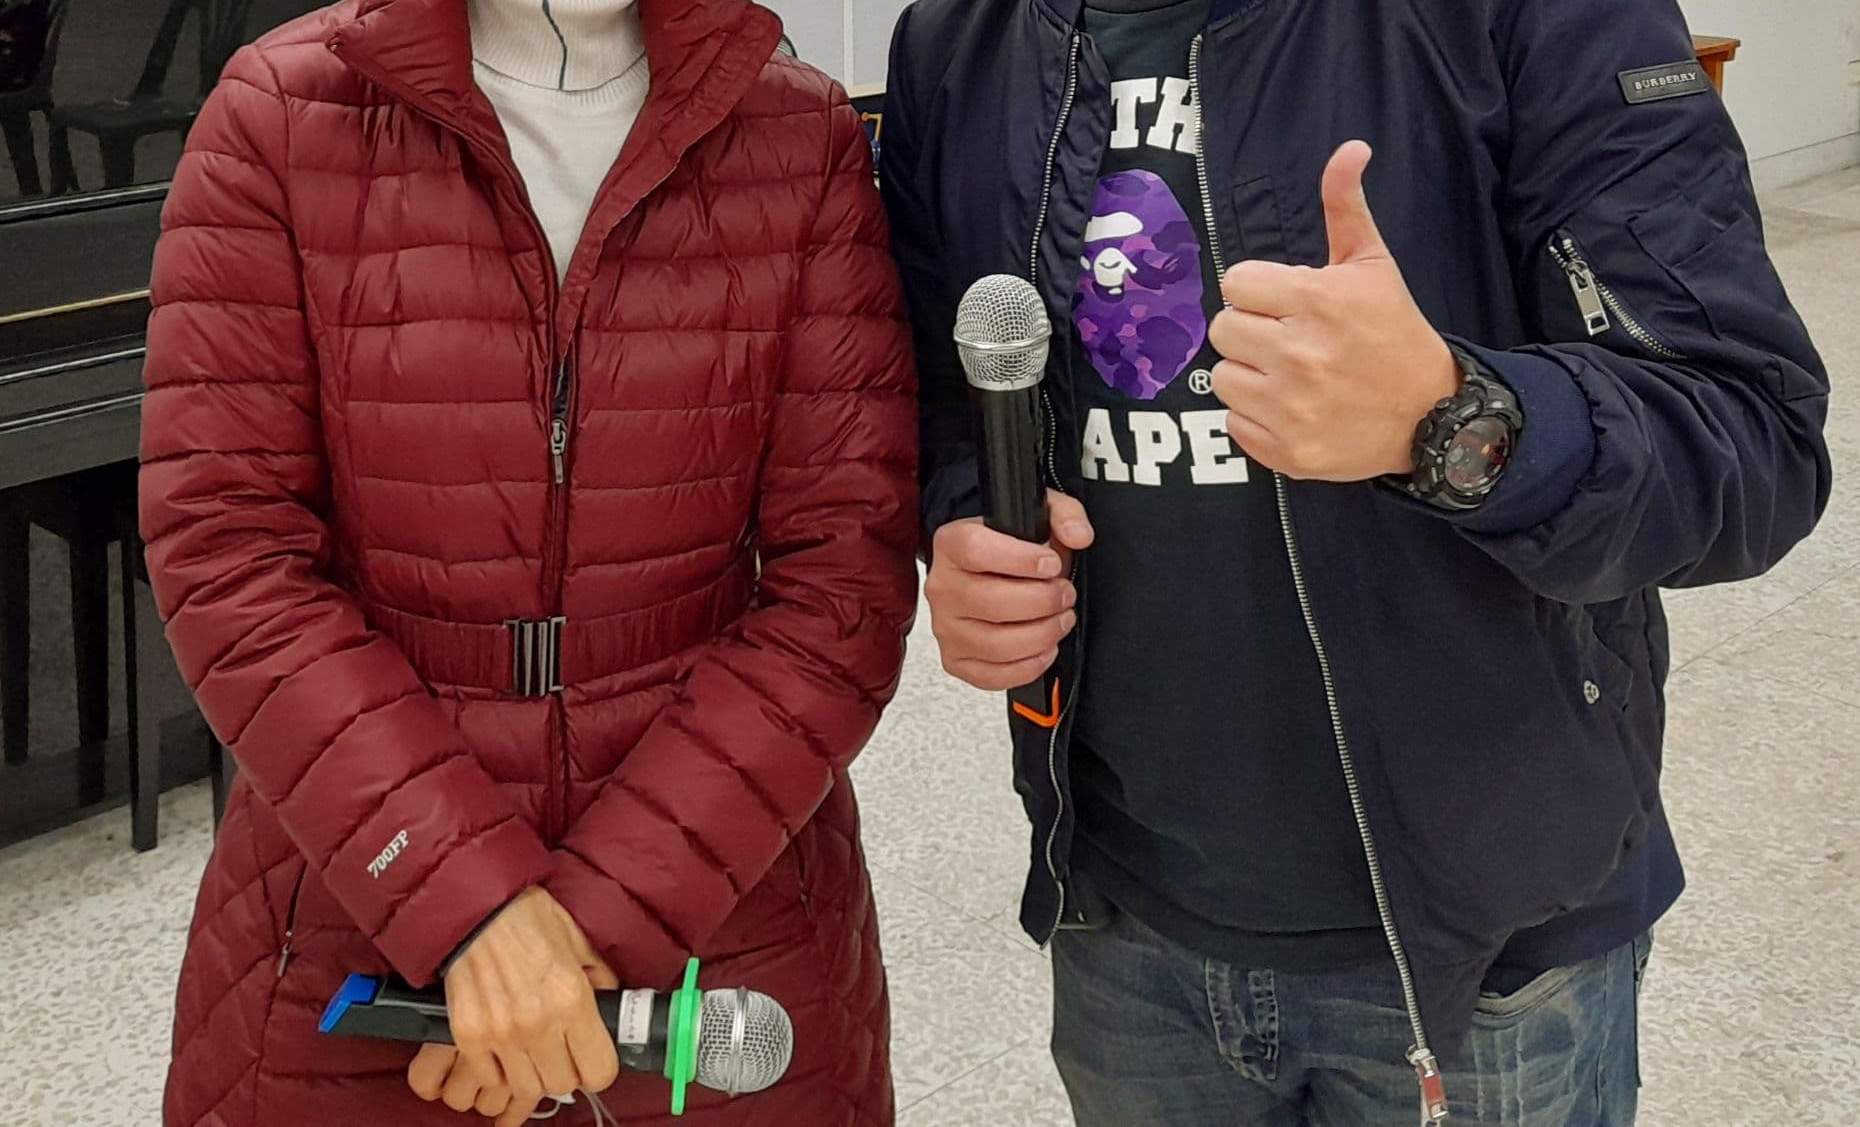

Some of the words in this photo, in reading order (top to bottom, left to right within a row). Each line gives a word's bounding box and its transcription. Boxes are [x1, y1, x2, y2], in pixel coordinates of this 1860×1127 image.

[1634, 72, 1696, 91] BURBERRY
[1080, 408, 1249, 486] APE
[367, 829, 409, 880] 700FP
